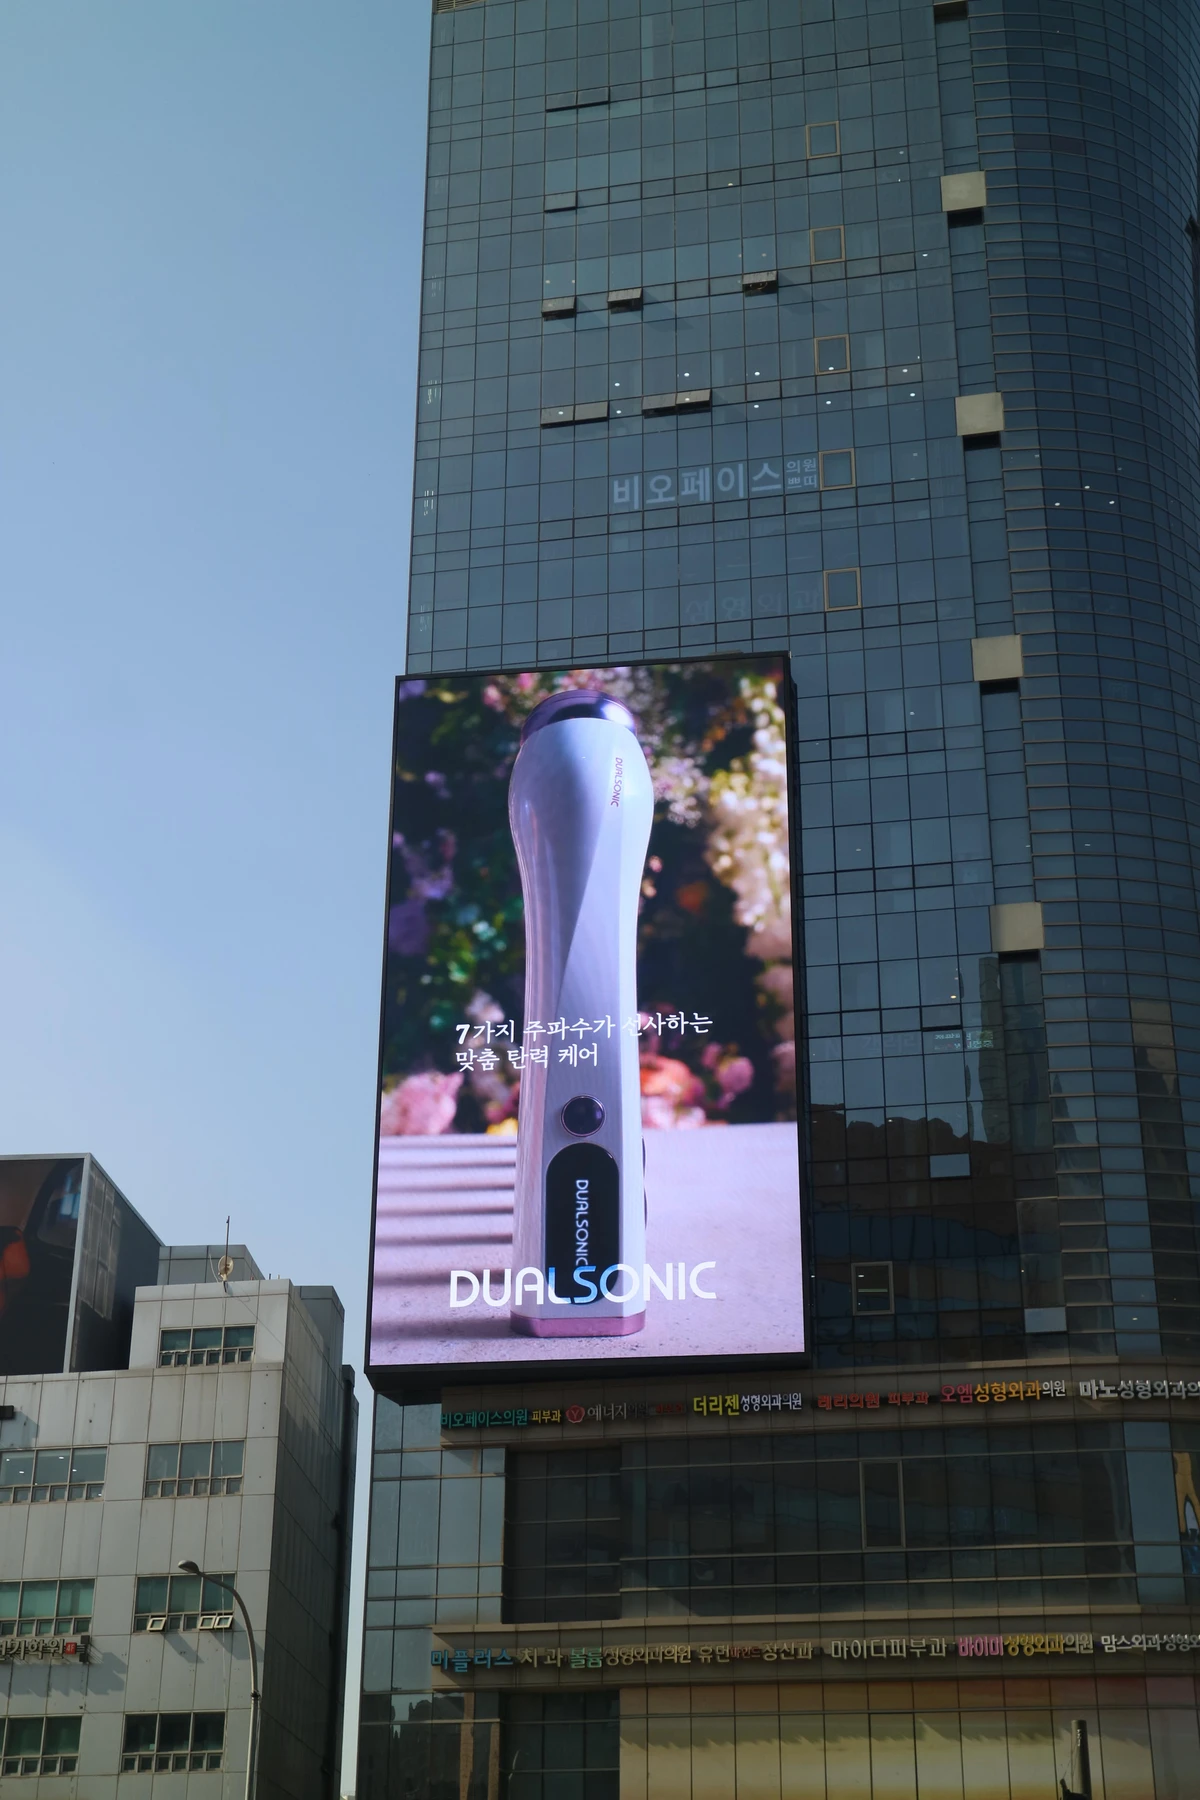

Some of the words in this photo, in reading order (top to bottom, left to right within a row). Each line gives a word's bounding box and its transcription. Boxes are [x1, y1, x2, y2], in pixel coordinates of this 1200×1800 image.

[786, 458, 817, 474] 의원
[613, 463, 782, 509] 비오페이스
[787, 474, 818, 489] 쁘띠
[610, 757, 633, 807] DUALSONIC
[456, 1019, 515, 1044] 7가지
[523, 1014, 616, 1041] 주파수가
[622, 1011, 713, 1036] 선사하는
[455, 1048, 500, 1072] 맞춤
[507, 1044, 548, 1069] 탄력
[558, 1043, 598, 1067] 케어
[575, 1179, 589, 1266] DUALSONIC
[450, 1261, 717, 1308] DUALSONIC
[817, 1391, 880, 1411] 레리의원
[887, 1390, 929, 1406] 피부과
[440, 1409, 529, 1428] 비오페이스의원
[532, 1409, 562, 1424] 피부과
[431, 1647, 514, 1673] 미플러스
